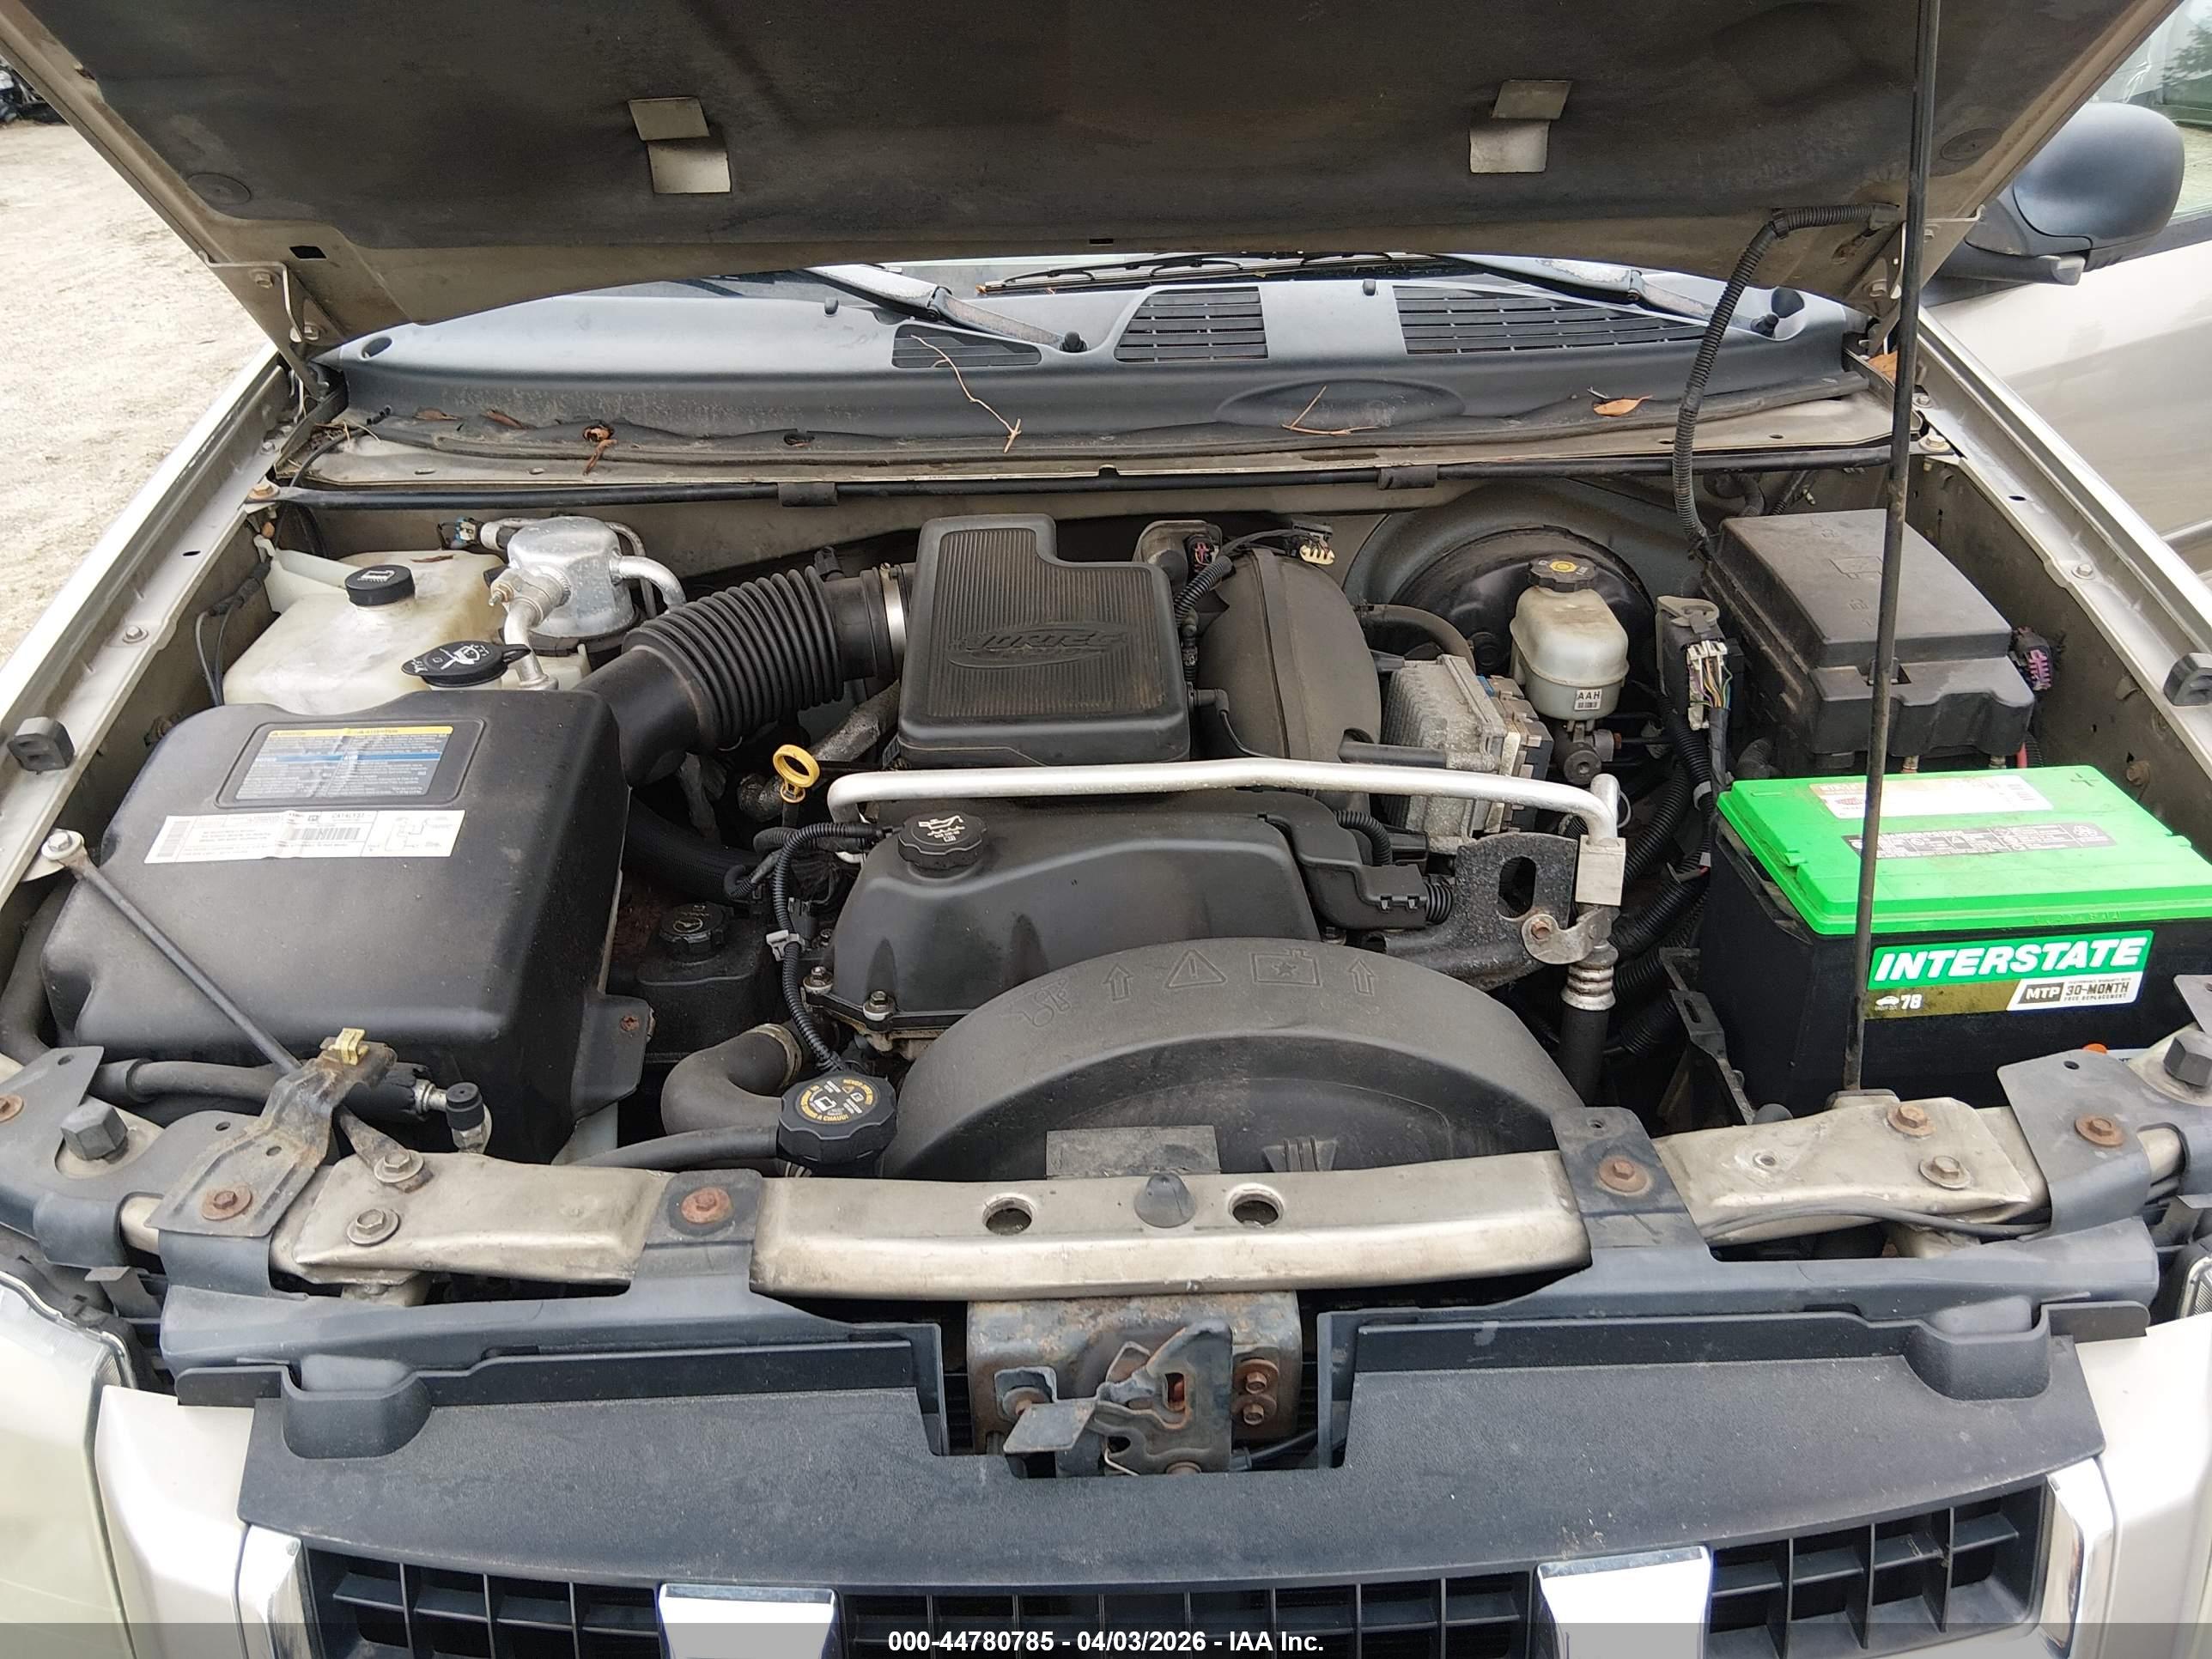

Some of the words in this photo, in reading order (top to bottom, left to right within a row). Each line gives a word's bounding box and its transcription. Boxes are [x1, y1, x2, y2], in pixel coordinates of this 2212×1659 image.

[1577, 690, 1601, 700] AAH
[1874, 937, 2148, 982] INTERSTATE
[2025, 986, 2060, 1000] MTP
[2065, 981, 2130, 996] 30-MONTH
[1900, 994, 1923, 1010] 78
